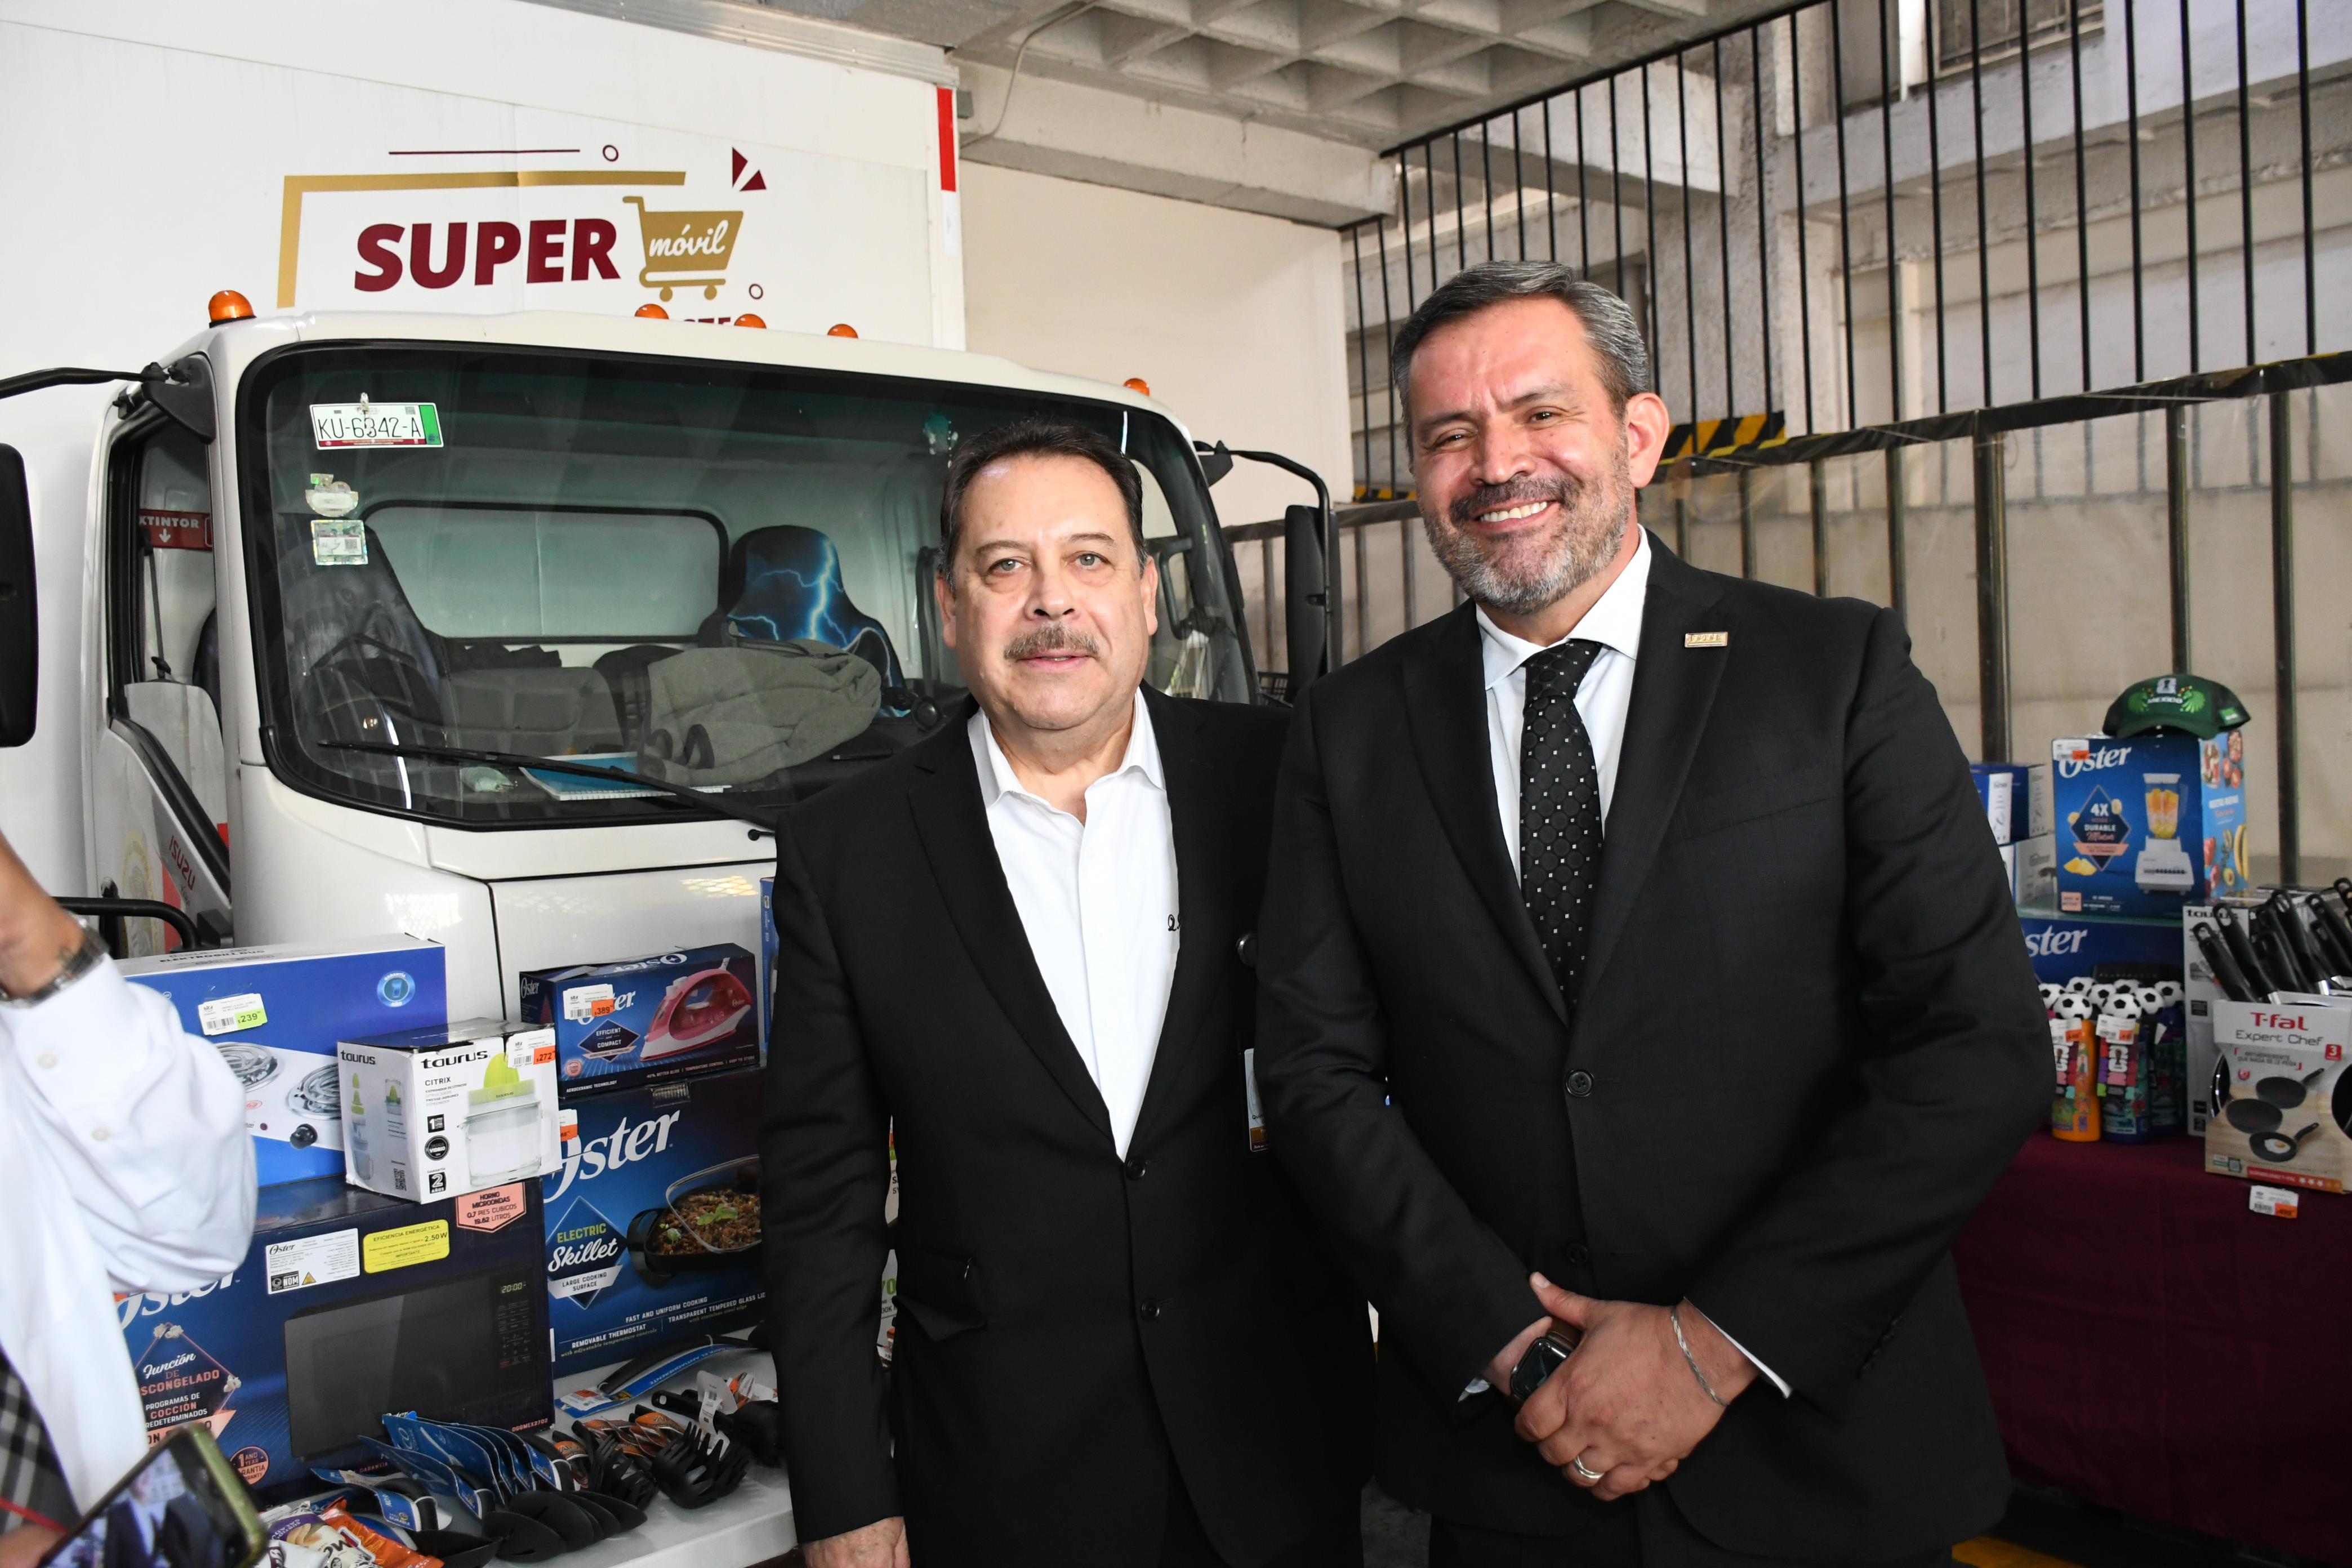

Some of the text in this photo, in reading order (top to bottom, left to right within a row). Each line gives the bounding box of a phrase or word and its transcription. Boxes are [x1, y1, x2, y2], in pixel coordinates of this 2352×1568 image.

[354, 219, 729, 292] SUPER móvil
[318, 417, 422, 439] KU-6342-A
[139, 516, 199, 528] XTINTOR
[2059, 746, 2132, 778] Oster
[2090, 803, 2109, 816] 4X
[170, 835, 195, 890] ISUZU
[2186, 909, 2238, 920] tauus
[2025, 925, 2088, 957] ster
[613, 954, 687, 972] Oster
[521, 977, 540, 999] Oster
[2250, 1012, 2309, 1031] T-fal
[596, 1027, 621, 1036] EFFICIENT
[2235, 1030, 2324, 1045] Expert Chef
[597, 1040, 622, 1048] COMPACT
[2329, 1045, 2337, 1055] 3
[340, 1050, 376, 1065] taurus
[421, 1050, 488, 1069] taurus
[425, 1076, 451, 1086] CITRIX
[566, 1080, 617, 1093] AEROCERAMIC TECHNOLOGY
[431, 1173, 443, 1188] 2
[472, 1196, 510, 1209] MICROONDAS
[480, 1192, 500, 1200] HORNO
[491, 1213, 511, 1222] LITROS
[373, 1232, 404, 1242] EFICIENCIA
[557, 1223, 607, 1244] ELECTRIC
[269, 1243, 295, 1255] Oster
[548, 1237, 618, 1272] Skillet
[283, 1276, 299, 1288] NOM
[562, 1272, 607, 1287] LARGE COOKING
[573, 1281, 598, 1291] SURFACE
[501, 1282, 523, 1294] 20:00
[625, 1297, 708, 1324] FAST AND UNIFORM COOKING
[669, 1307, 707, 1323] TRANSPARENT
[709, 1300, 737, 1313] TEMPERED
[738, 1295, 756, 1304] GLASS
[572, 1324, 647, 1349] REMOVABLE THERMOSTAT
[573, 1342, 602, 1356] adjustable
[603, 1334, 635, 1348] temperature
[143, 1352, 196, 1379] Función
[166, 1370, 180, 1379] DE
[140, 1369, 220, 1396] SCONGELADO
[146, 1395, 189, 1411] PROGRAMAS
[146, 1408, 208, 1429] REDETERMINADOS
[239, 1453, 244, 1467] 1
[242, 1464, 265, 1475] RANTIA
